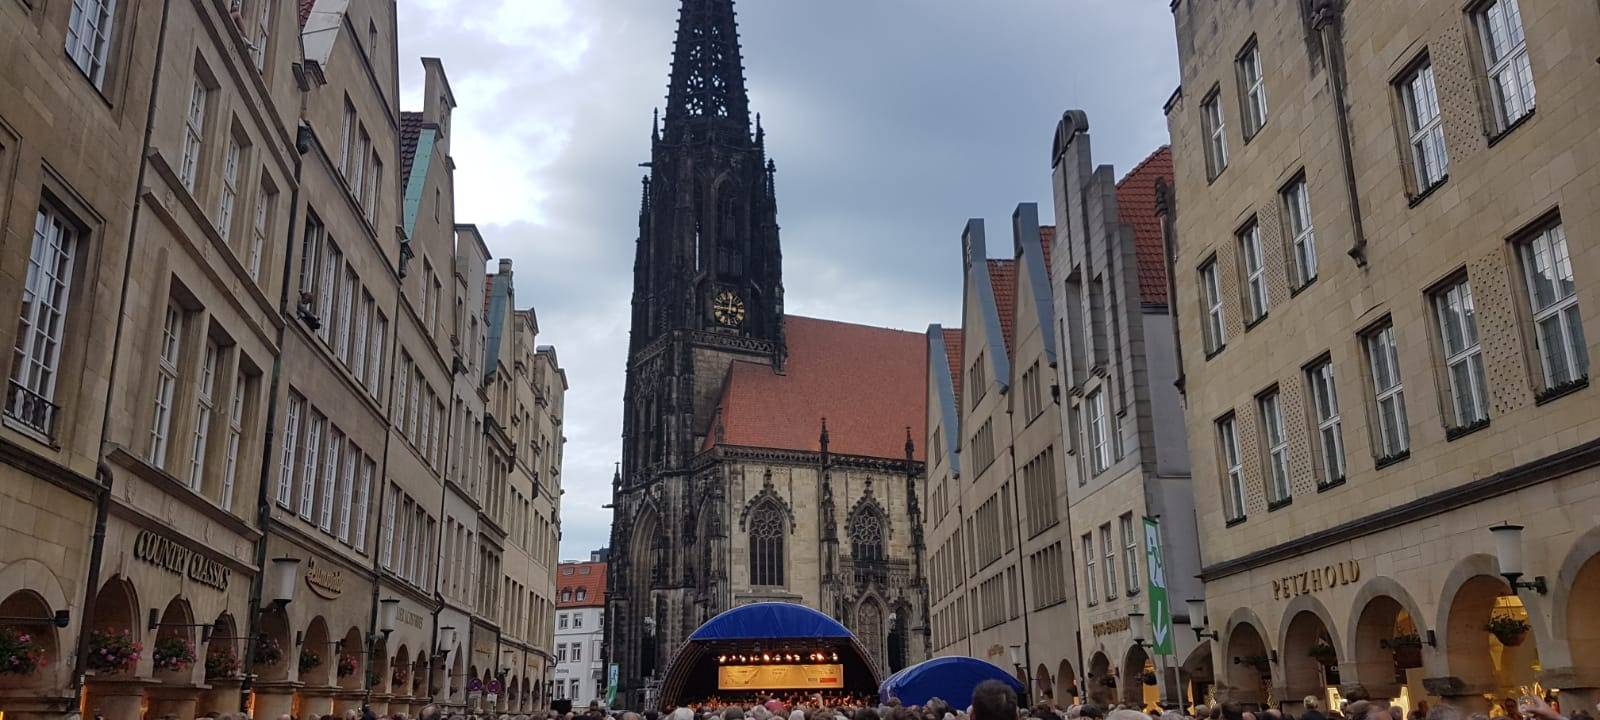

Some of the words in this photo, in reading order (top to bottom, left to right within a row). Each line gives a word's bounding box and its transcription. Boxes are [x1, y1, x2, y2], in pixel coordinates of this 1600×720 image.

[134, 529, 194, 575] COUNTRY
[188, 553, 232, 592] CLASSICS
[1272, 559, 1360, 600] PETZHOLD
